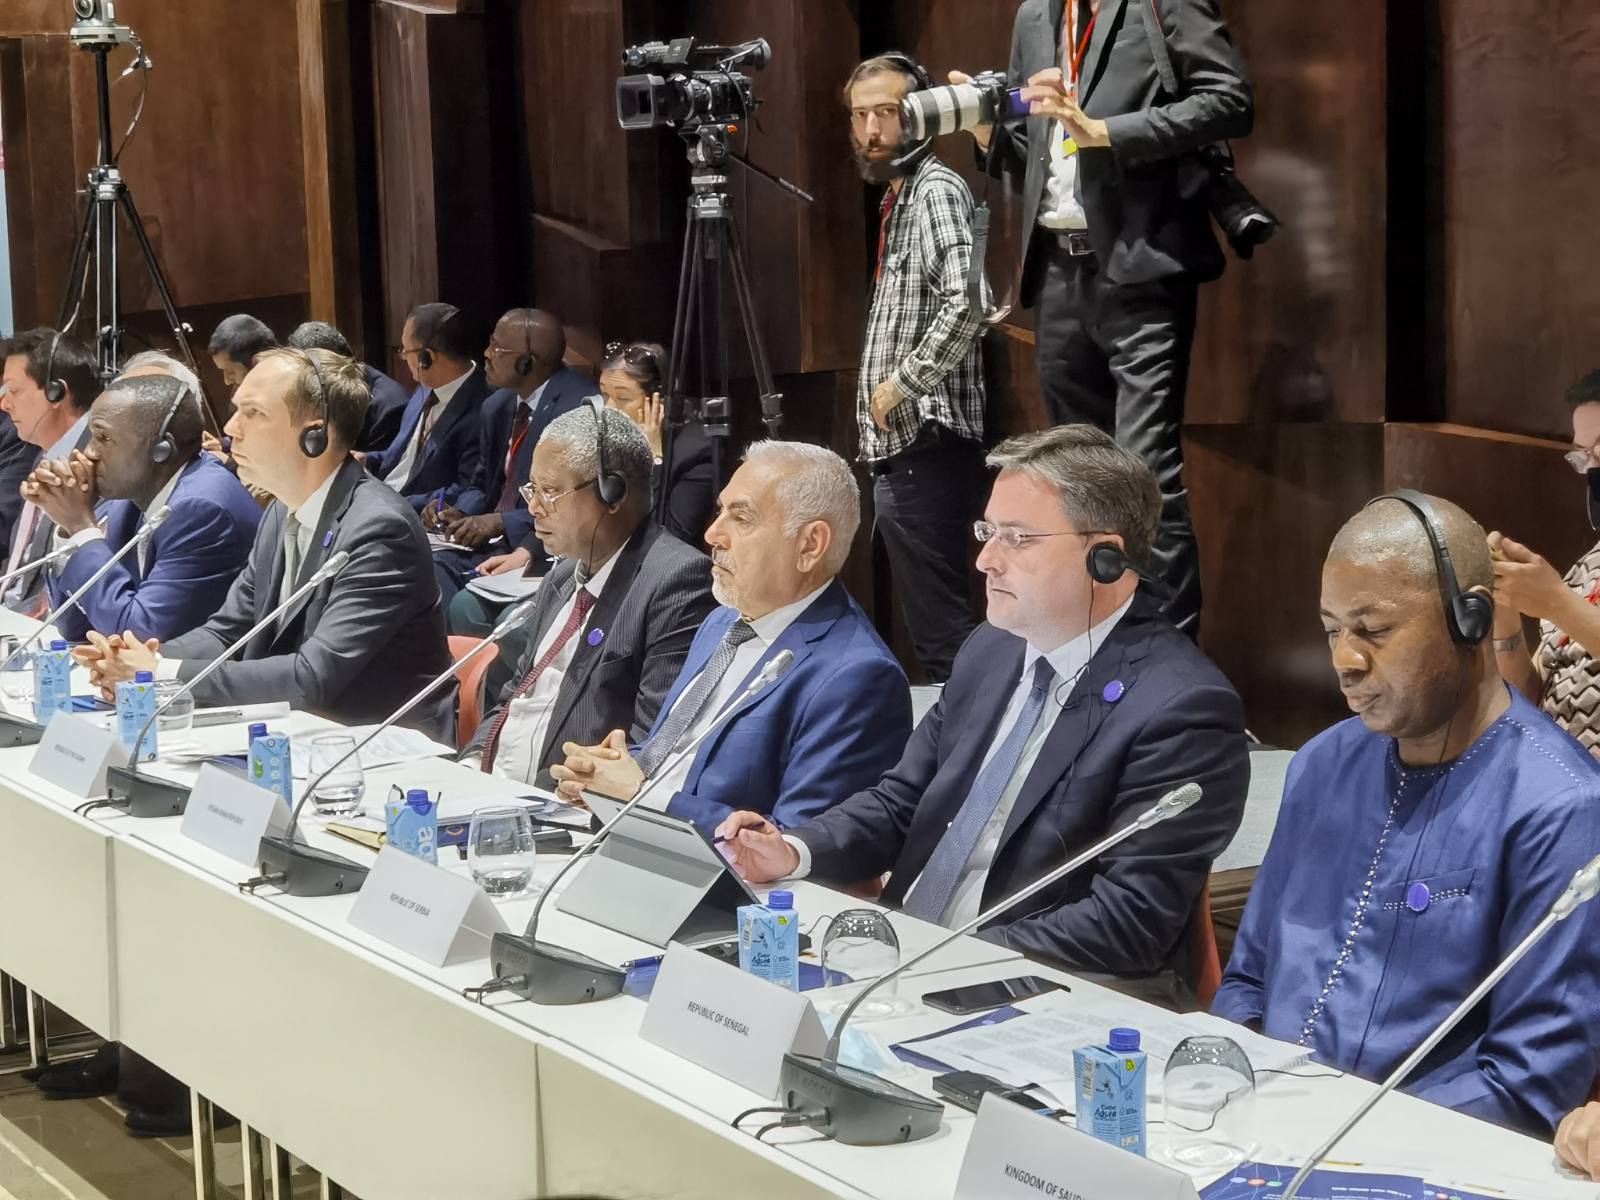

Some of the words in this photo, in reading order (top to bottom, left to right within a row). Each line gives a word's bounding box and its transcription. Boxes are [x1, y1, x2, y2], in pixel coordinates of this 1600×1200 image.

[687, 1000, 715, 1020] REPUBLIC
[714, 1013, 724, 1023] OF
[723, 1016, 750, 1036] SENEGAL
[1004, 1163, 1046, 1191] KINGDOM
[1045, 1182, 1058, 1196] OF
[1058, 1188, 1086, 1200] SAU
